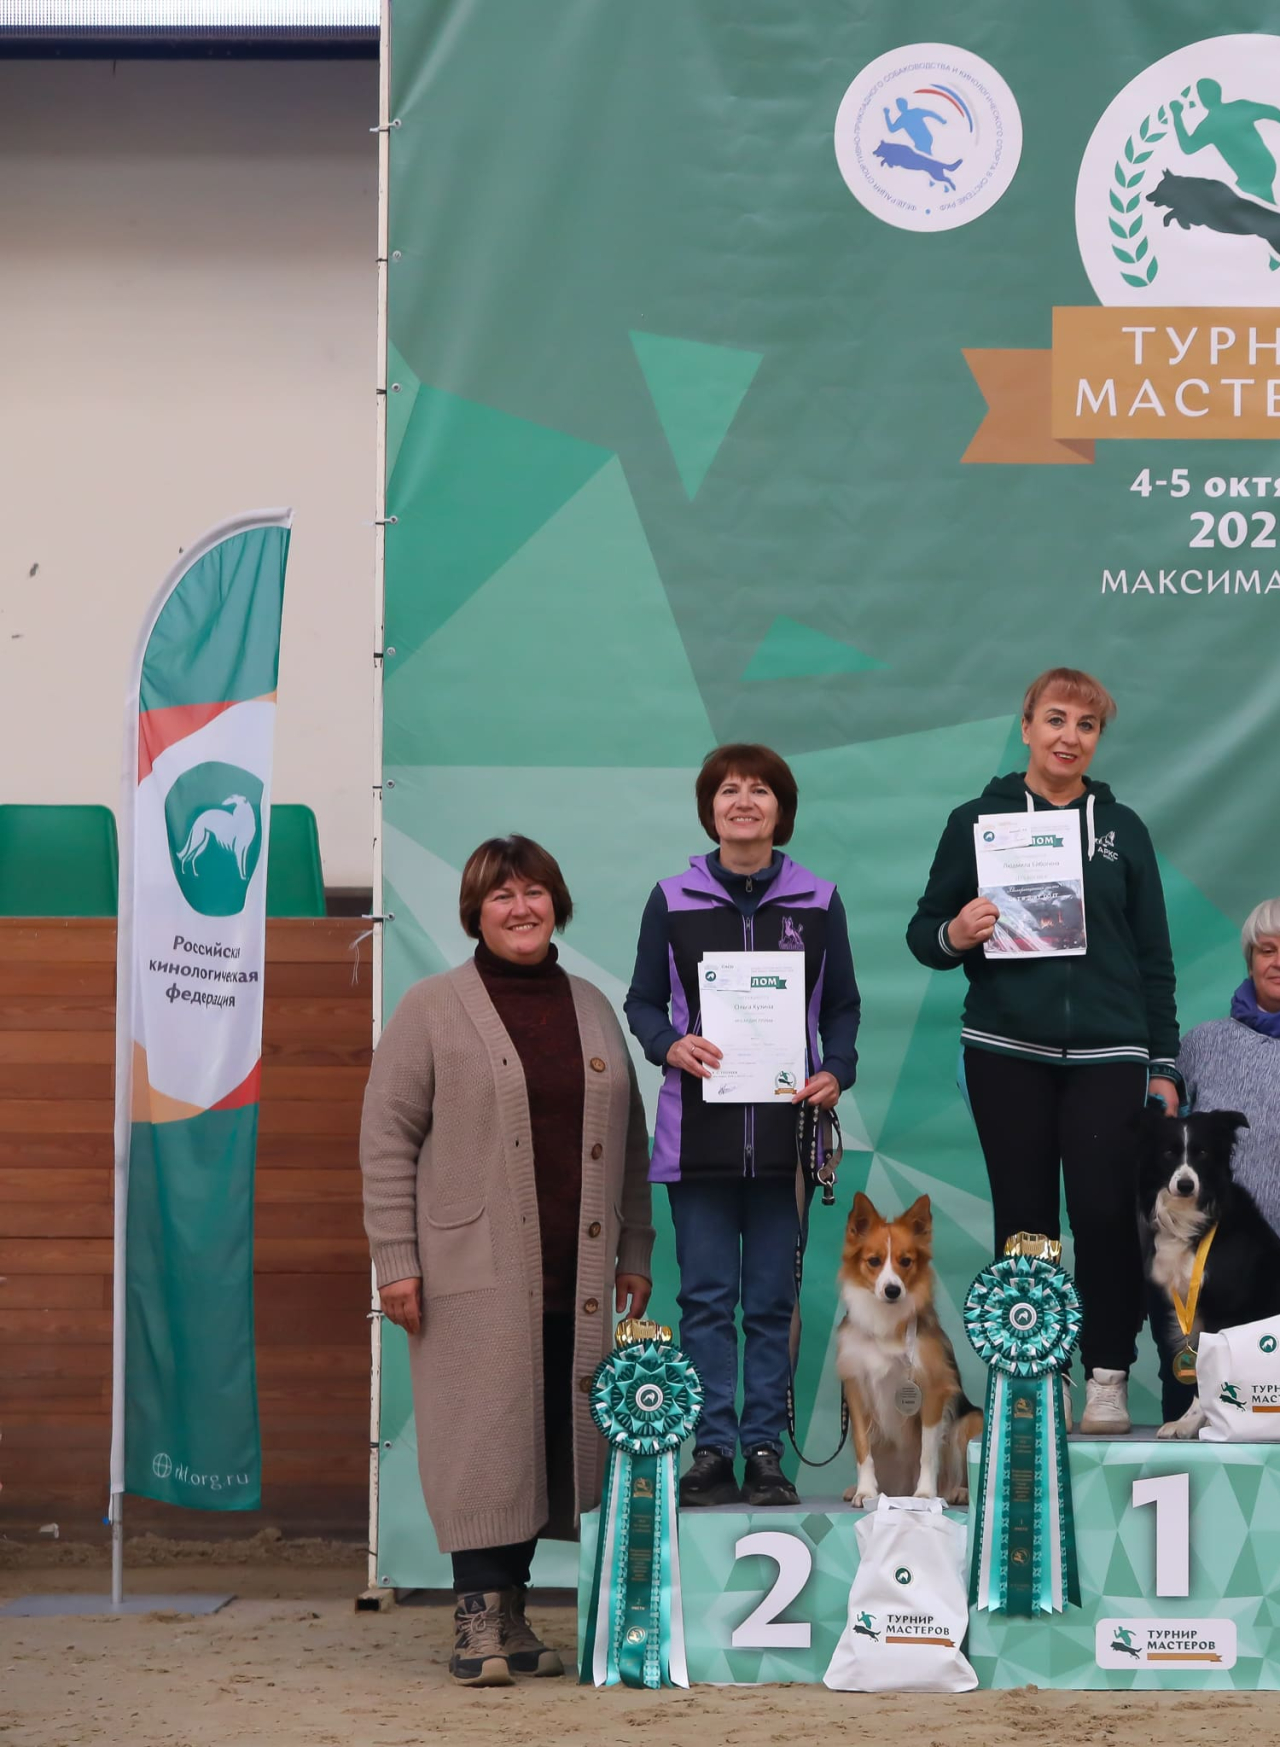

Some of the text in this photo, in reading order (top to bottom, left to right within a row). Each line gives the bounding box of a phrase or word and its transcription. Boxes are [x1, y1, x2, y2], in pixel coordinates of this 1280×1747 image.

[873, 184, 917, 211] ФЕДЕРАЦИЯ
[1130, 469, 1191, 498] 4-5
[149, 959, 258, 983] кинологическая
[752, 977, 777, 986] ЛОМ
[165, 983, 236, 1009] федерация
[1132, 1473, 1189, 1597] 1
[732, 1531, 812, 1647] 2
[886, 1625, 950, 1636] МАСТЕРОВ
[887, 1614, 934, 1625] ТУРНИР
[1147, 1630, 1198, 1640] ТУРНИР
[1147, 1640, 1216, 1650] МАСТЕРОВ
